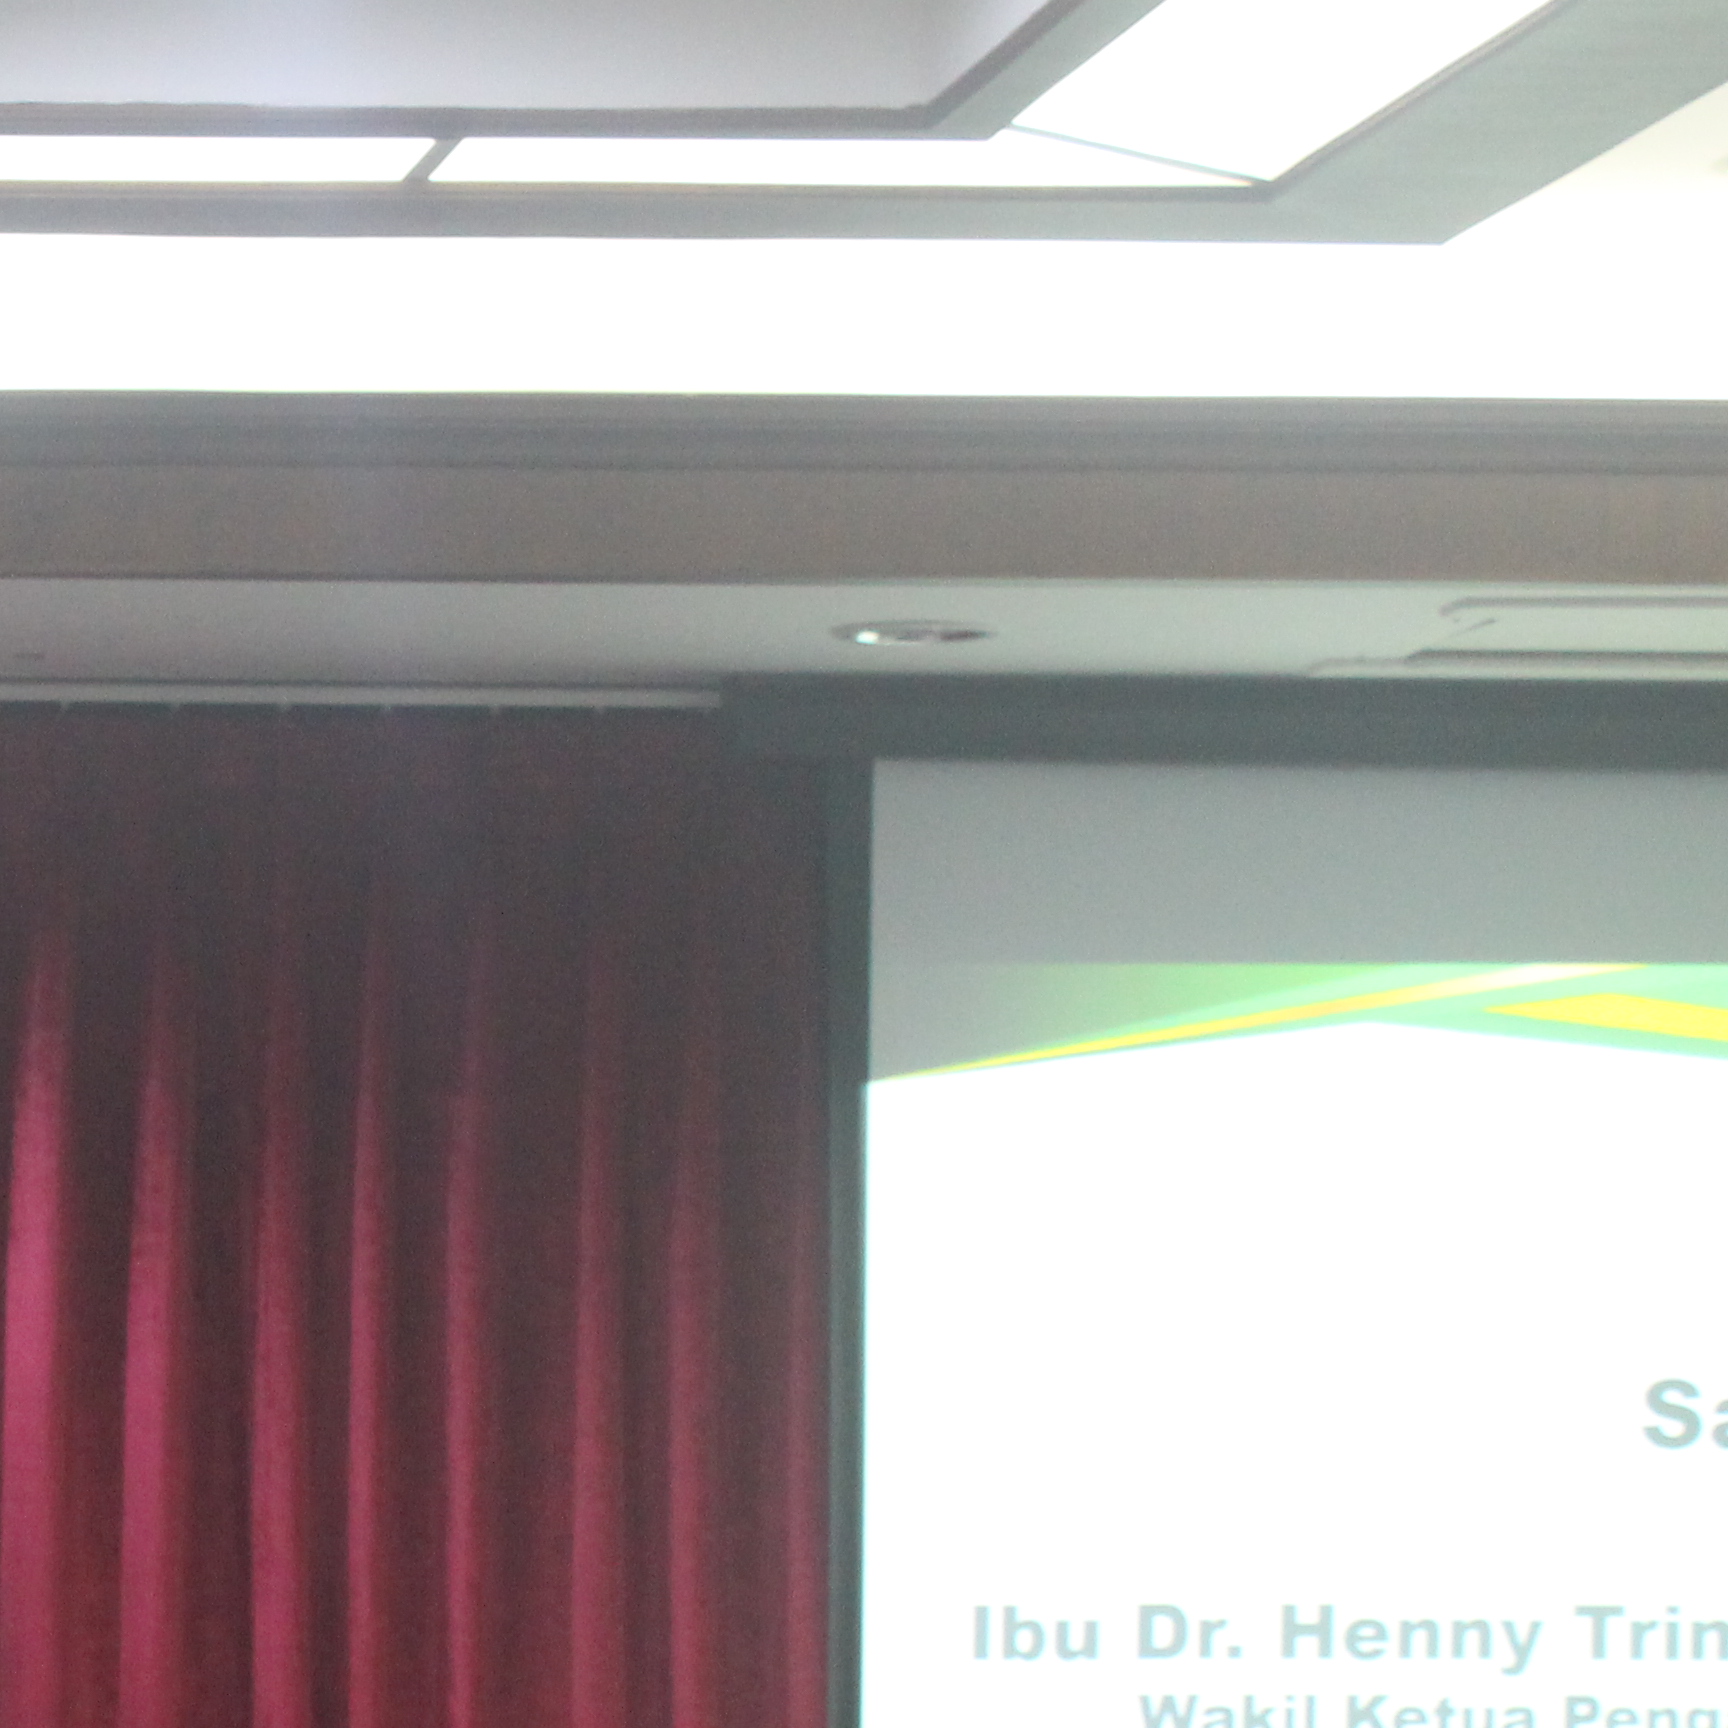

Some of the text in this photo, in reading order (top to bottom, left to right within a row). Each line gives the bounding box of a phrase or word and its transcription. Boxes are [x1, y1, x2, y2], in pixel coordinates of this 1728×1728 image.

[973, 1604, 1728, 1676] Ibu Dr. Henny Trin
